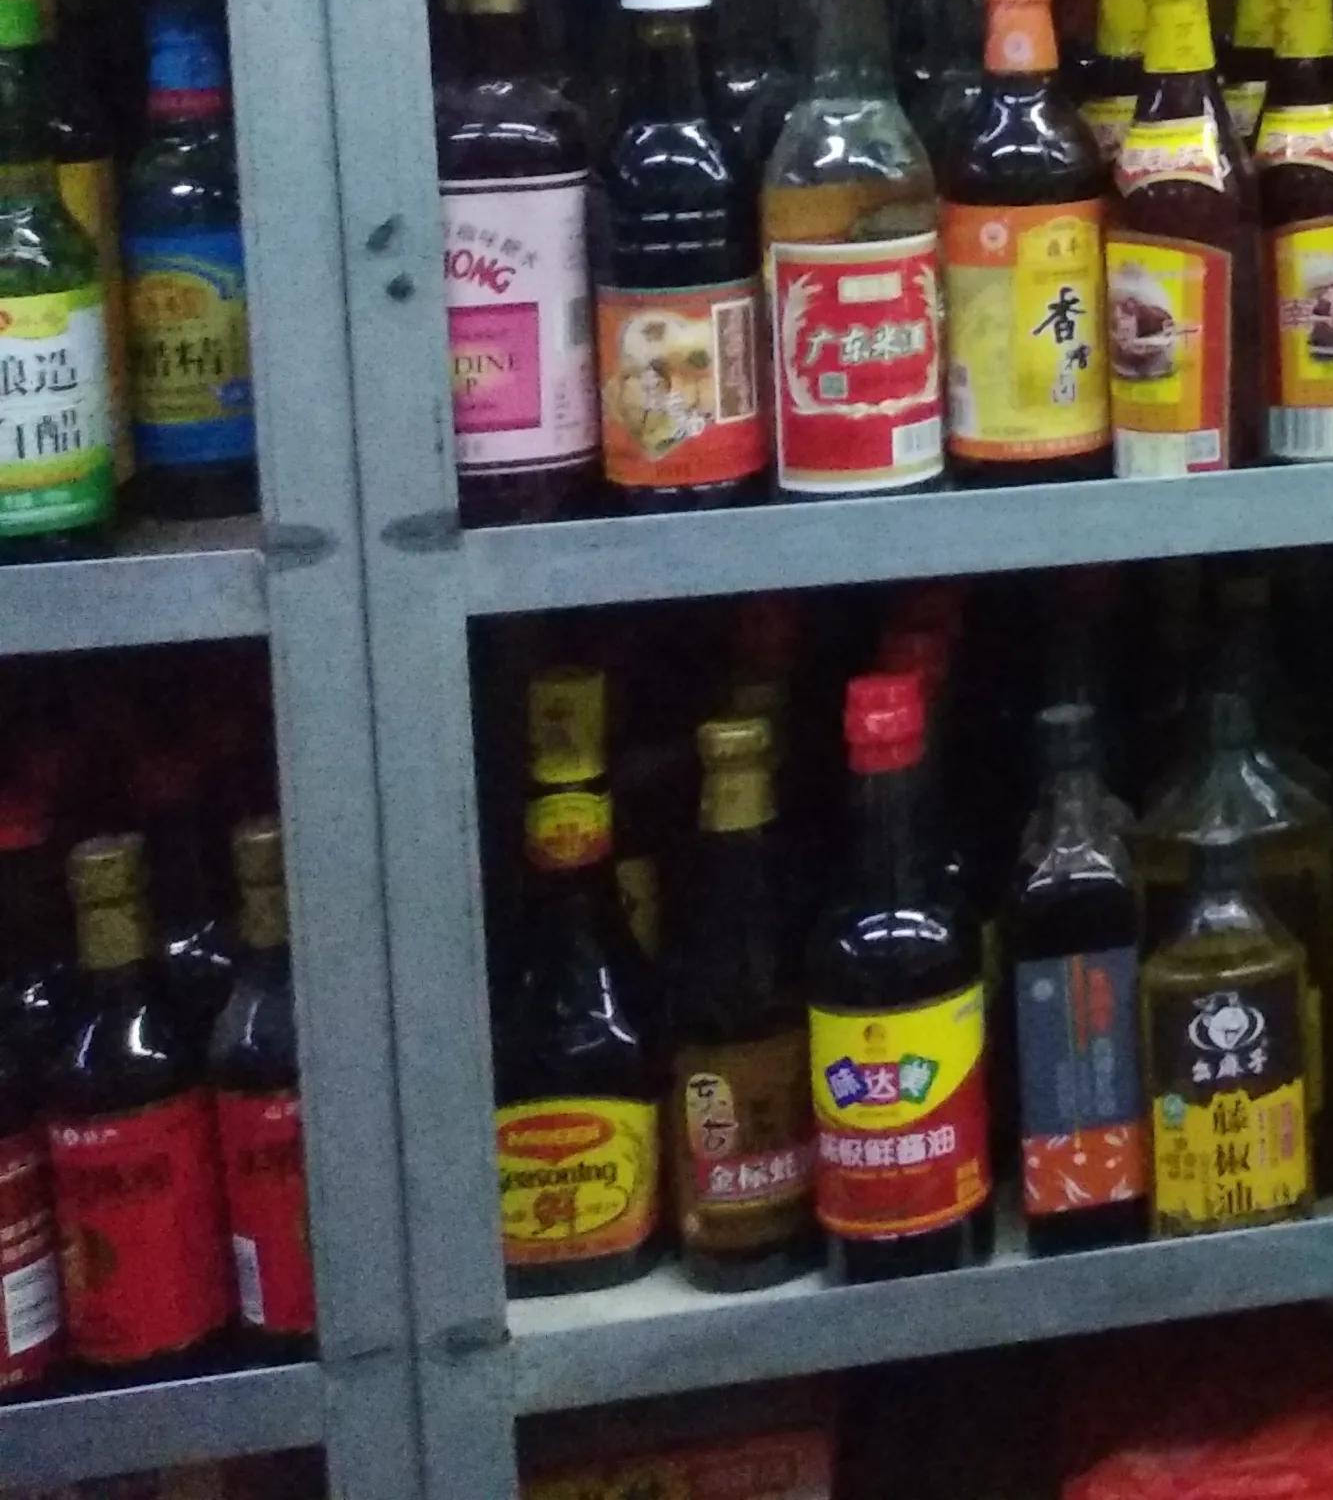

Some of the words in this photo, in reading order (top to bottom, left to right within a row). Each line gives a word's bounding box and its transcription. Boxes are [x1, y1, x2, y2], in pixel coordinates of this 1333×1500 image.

[806, 322, 927, 367] 广东米酒
[819, 1123, 955, 1167] 味极鲜酱油
